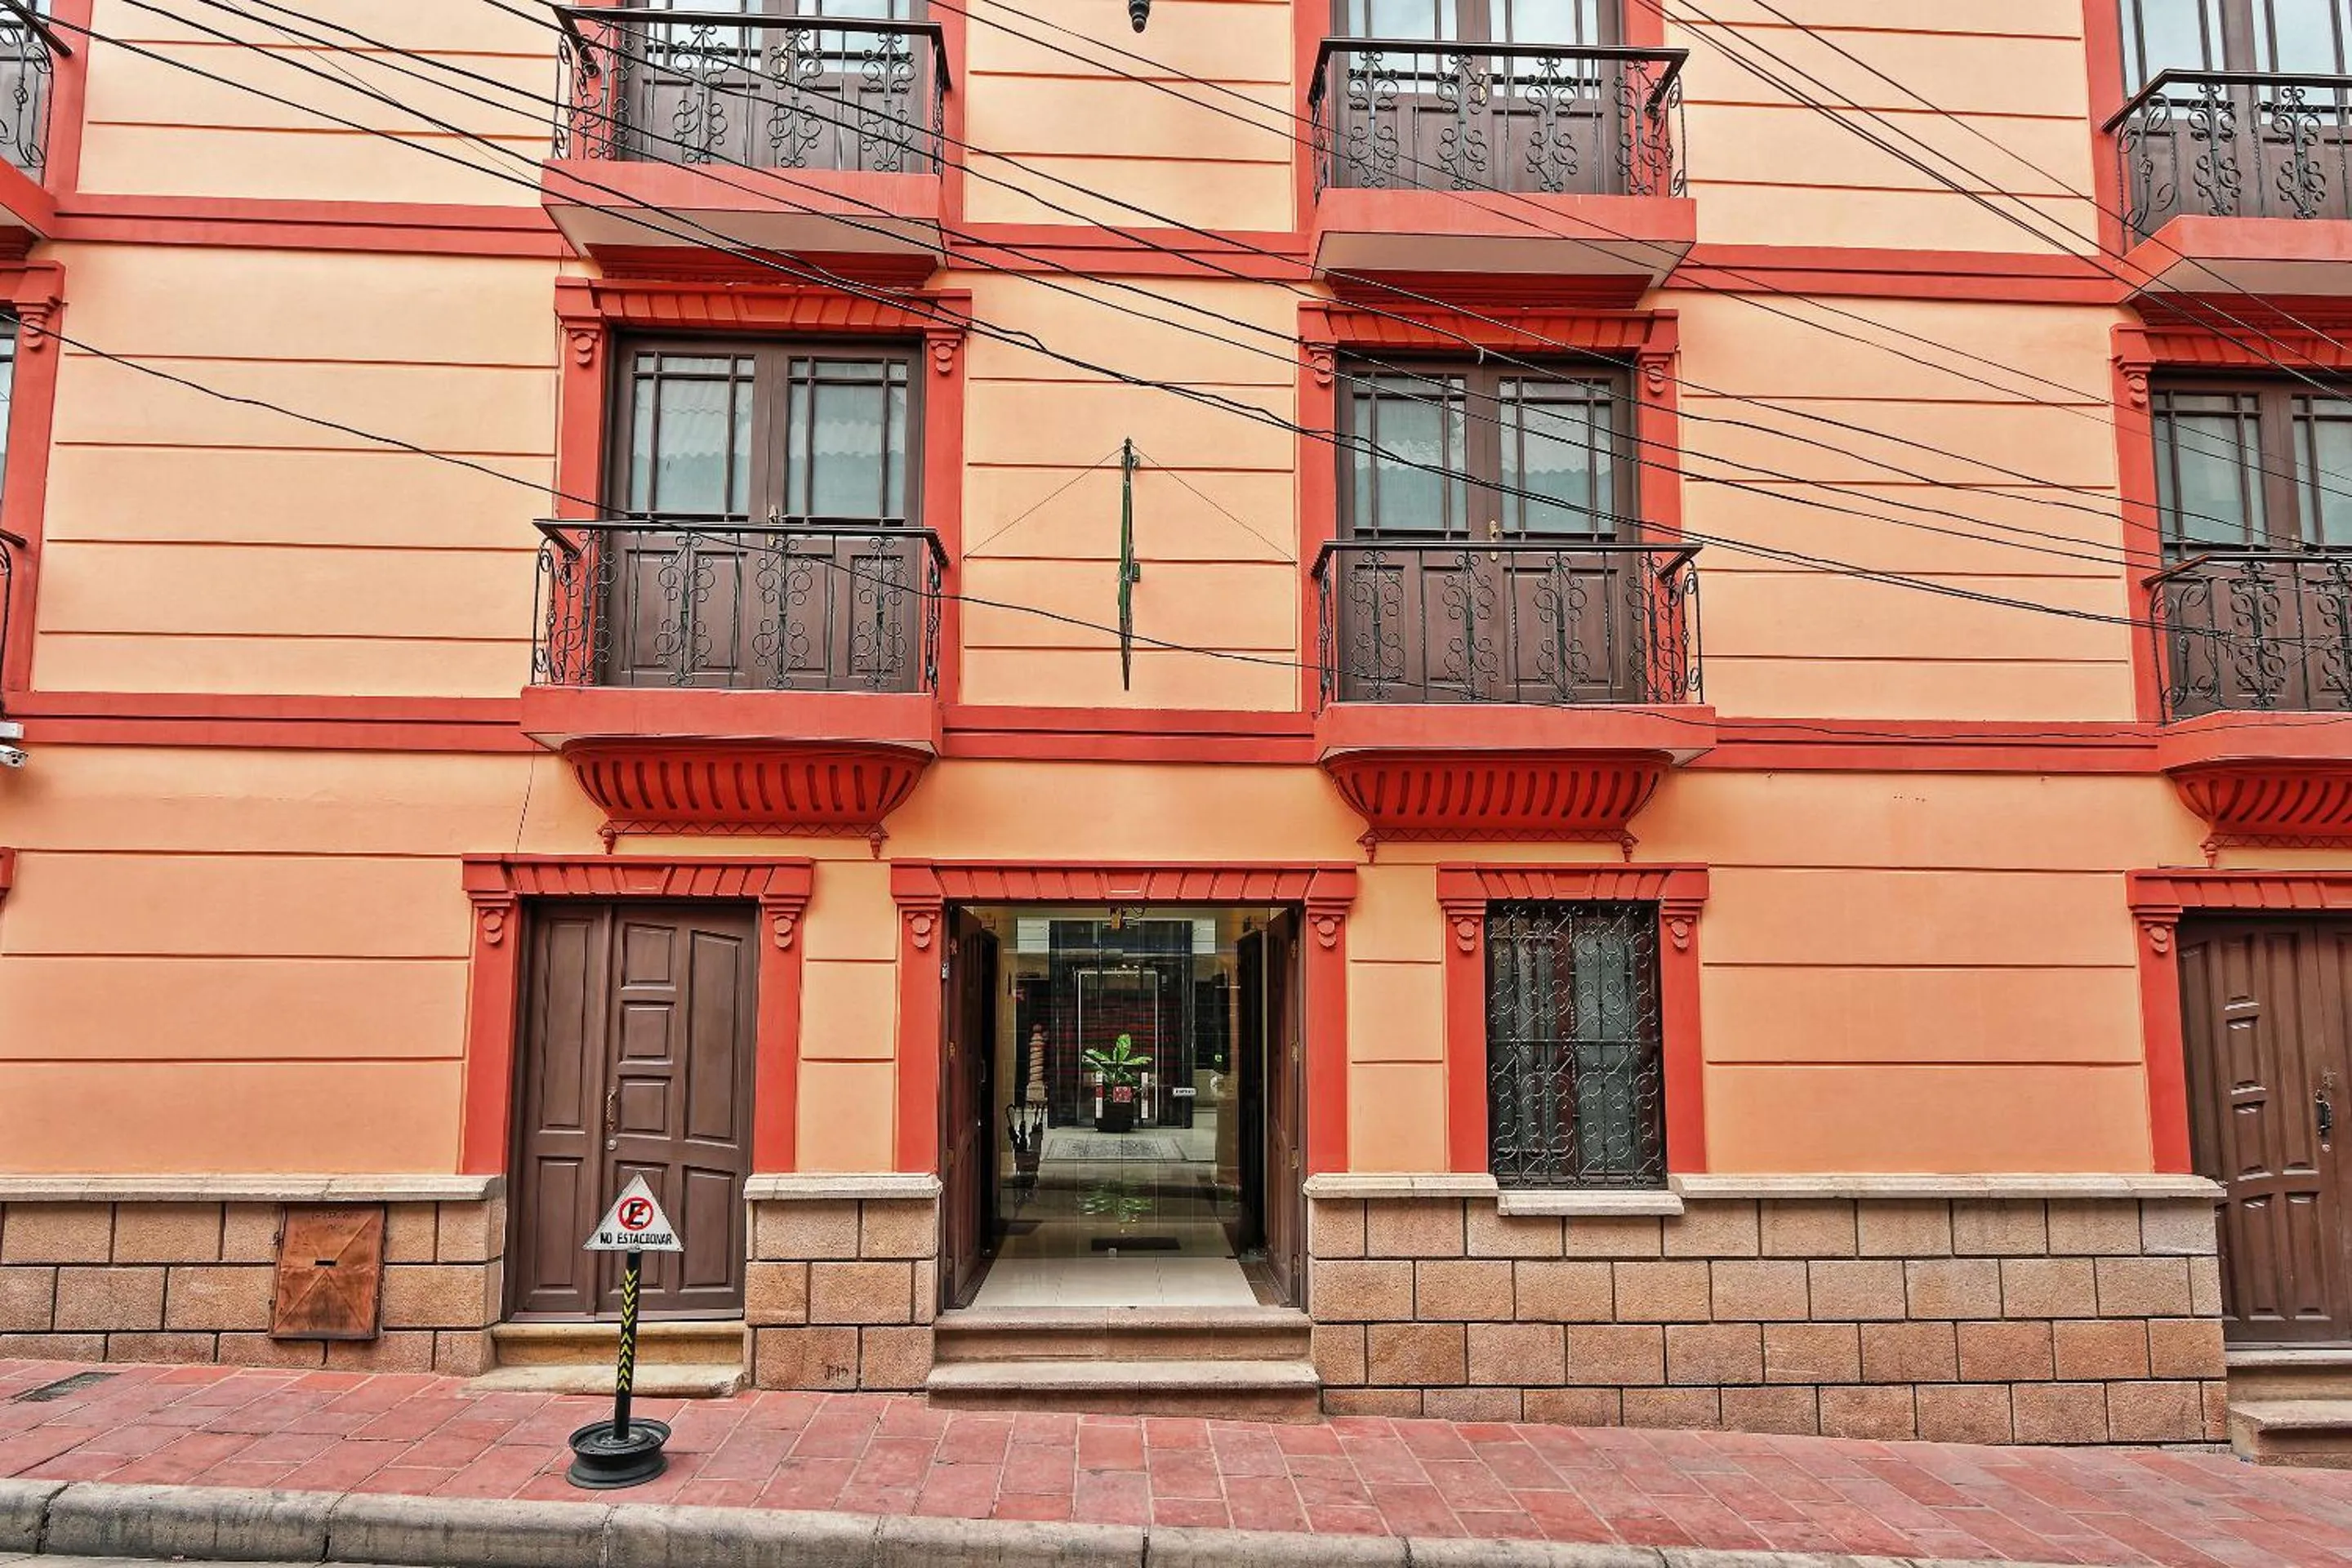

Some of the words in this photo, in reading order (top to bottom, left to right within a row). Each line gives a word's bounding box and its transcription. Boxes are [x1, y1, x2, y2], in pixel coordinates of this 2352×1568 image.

[628, 1202, 644, 1226] E
[600, 1232, 612, 1244] NO
[617, 1233, 672, 1245] ESTACIONAR
